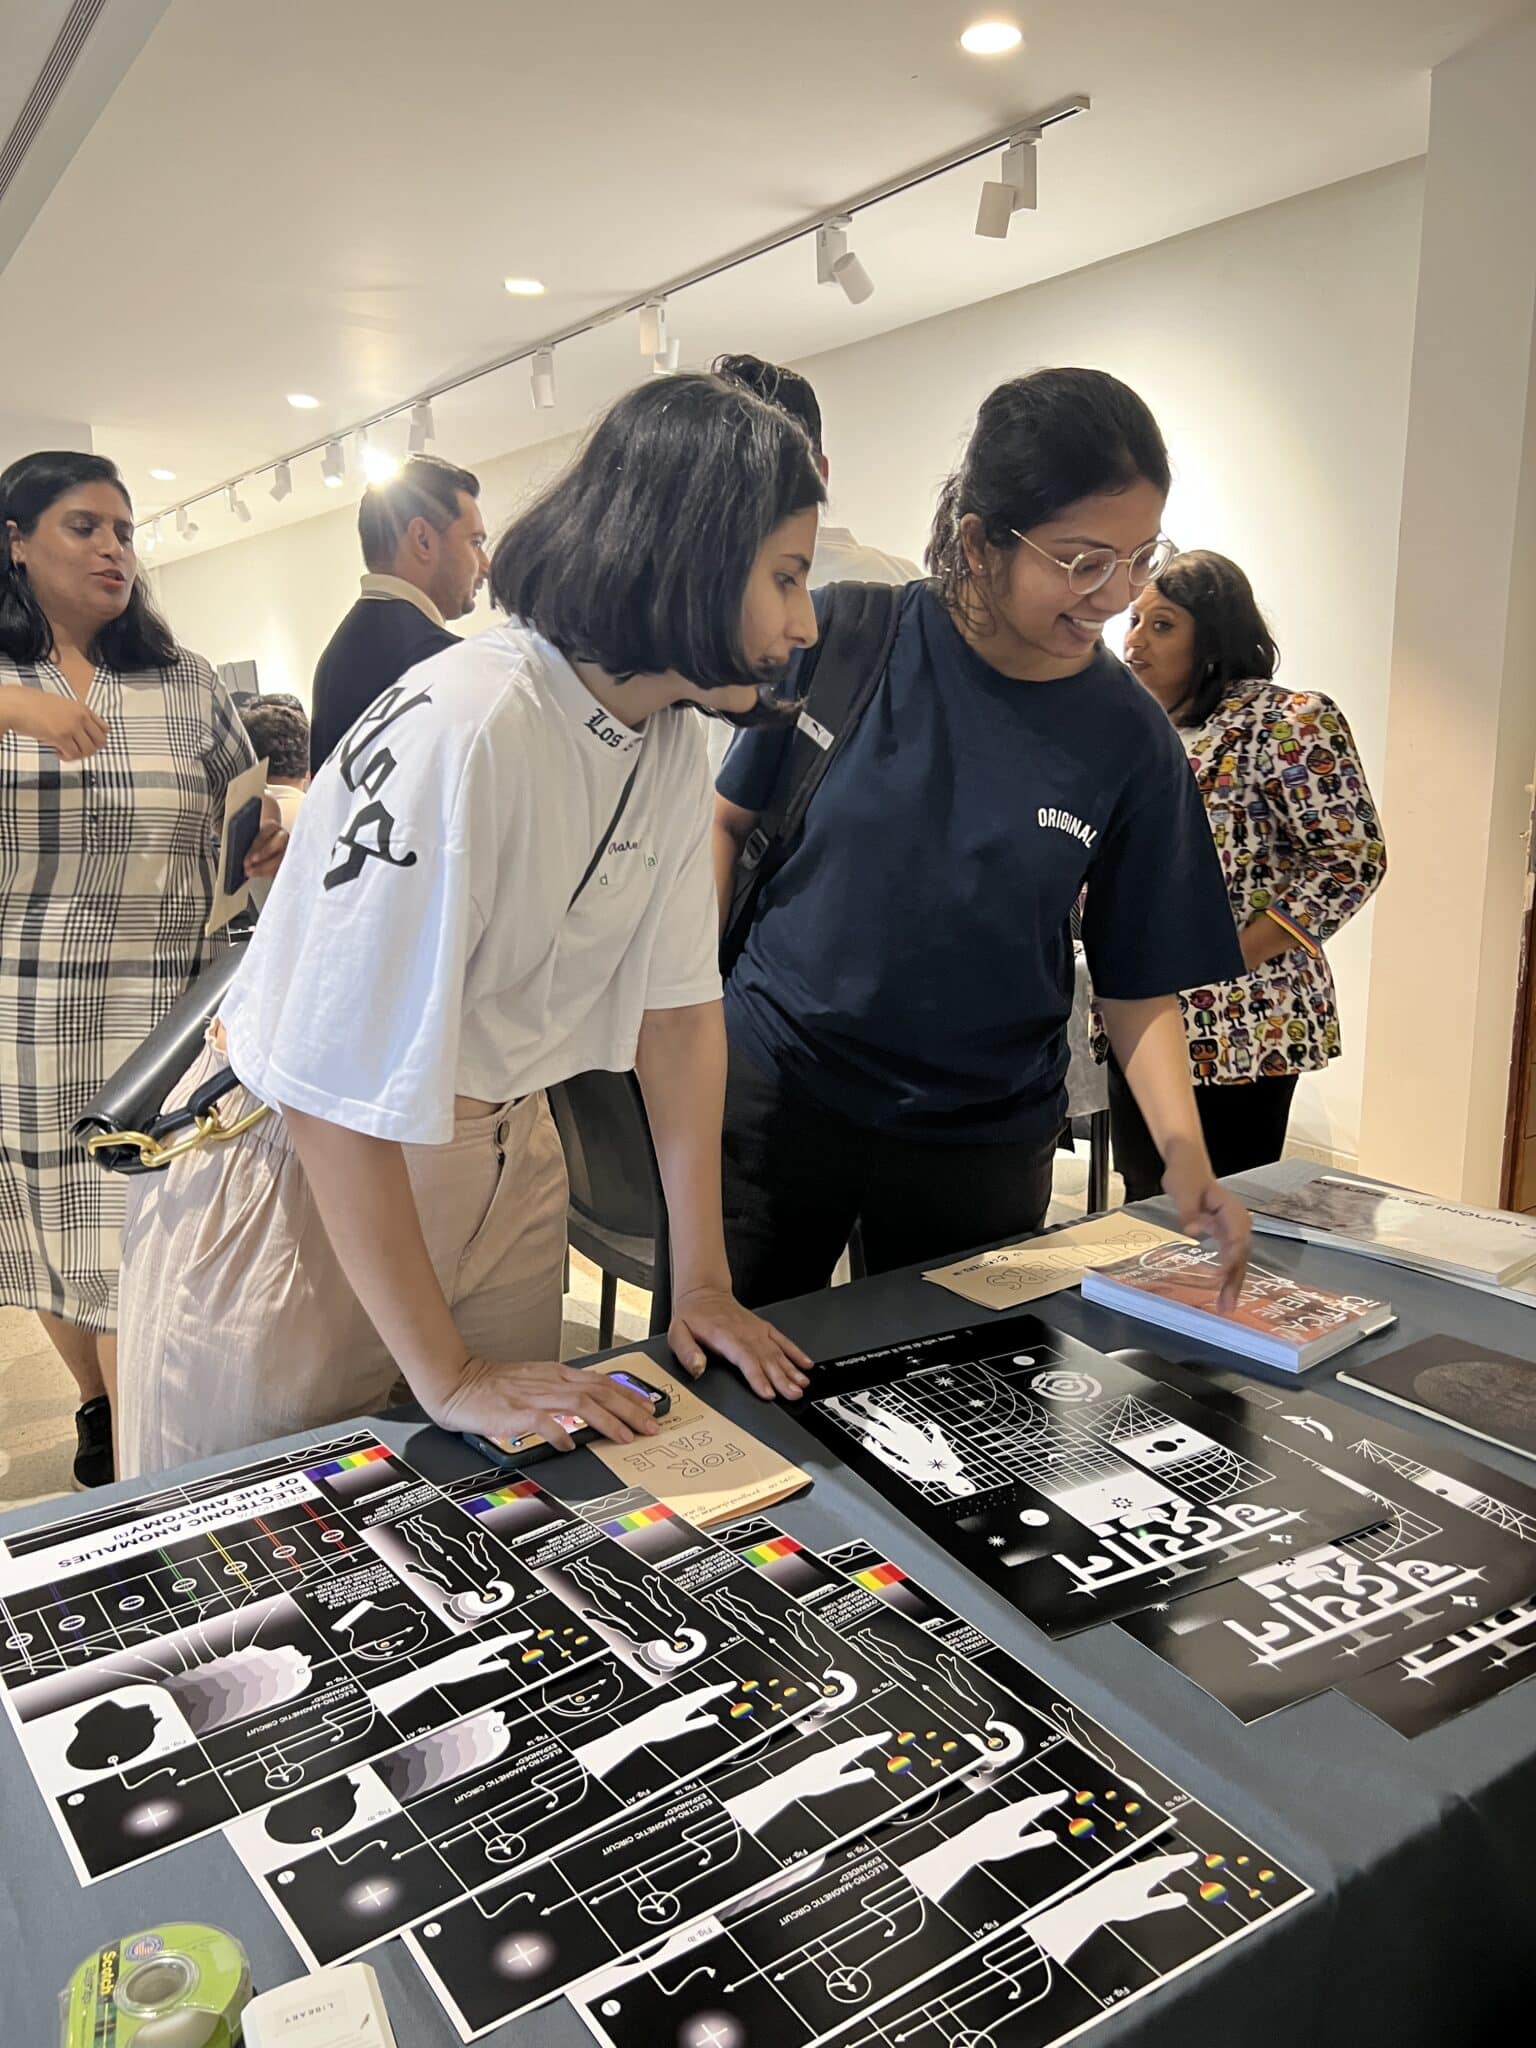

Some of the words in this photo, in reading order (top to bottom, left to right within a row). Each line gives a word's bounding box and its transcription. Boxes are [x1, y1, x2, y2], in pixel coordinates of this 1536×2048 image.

[1038, 807, 1097, 849] ORIGINAL
[1403, 1198, 1434, 1207] OF
[1436, 1205, 1523, 1227] INQUIRY
[1252, 1290, 1318, 1319] MEME
[1270, 1296, 1369, 1340] CRITICAL
[623, 1430, 713, 1472] SALE
[666, 1443, 746, 1479] FOR
[243, 1487, 275, 1502] THE
[276, 1477, 299, 1490] OF
[188, 1485, 307, 1527] ELECTRONIC
[57, 1525, 181, 1568] ANOMALIES
[100, 1951, 117, 1997] Scotch
[285, 2002, 333, 2025] LIBRARY
